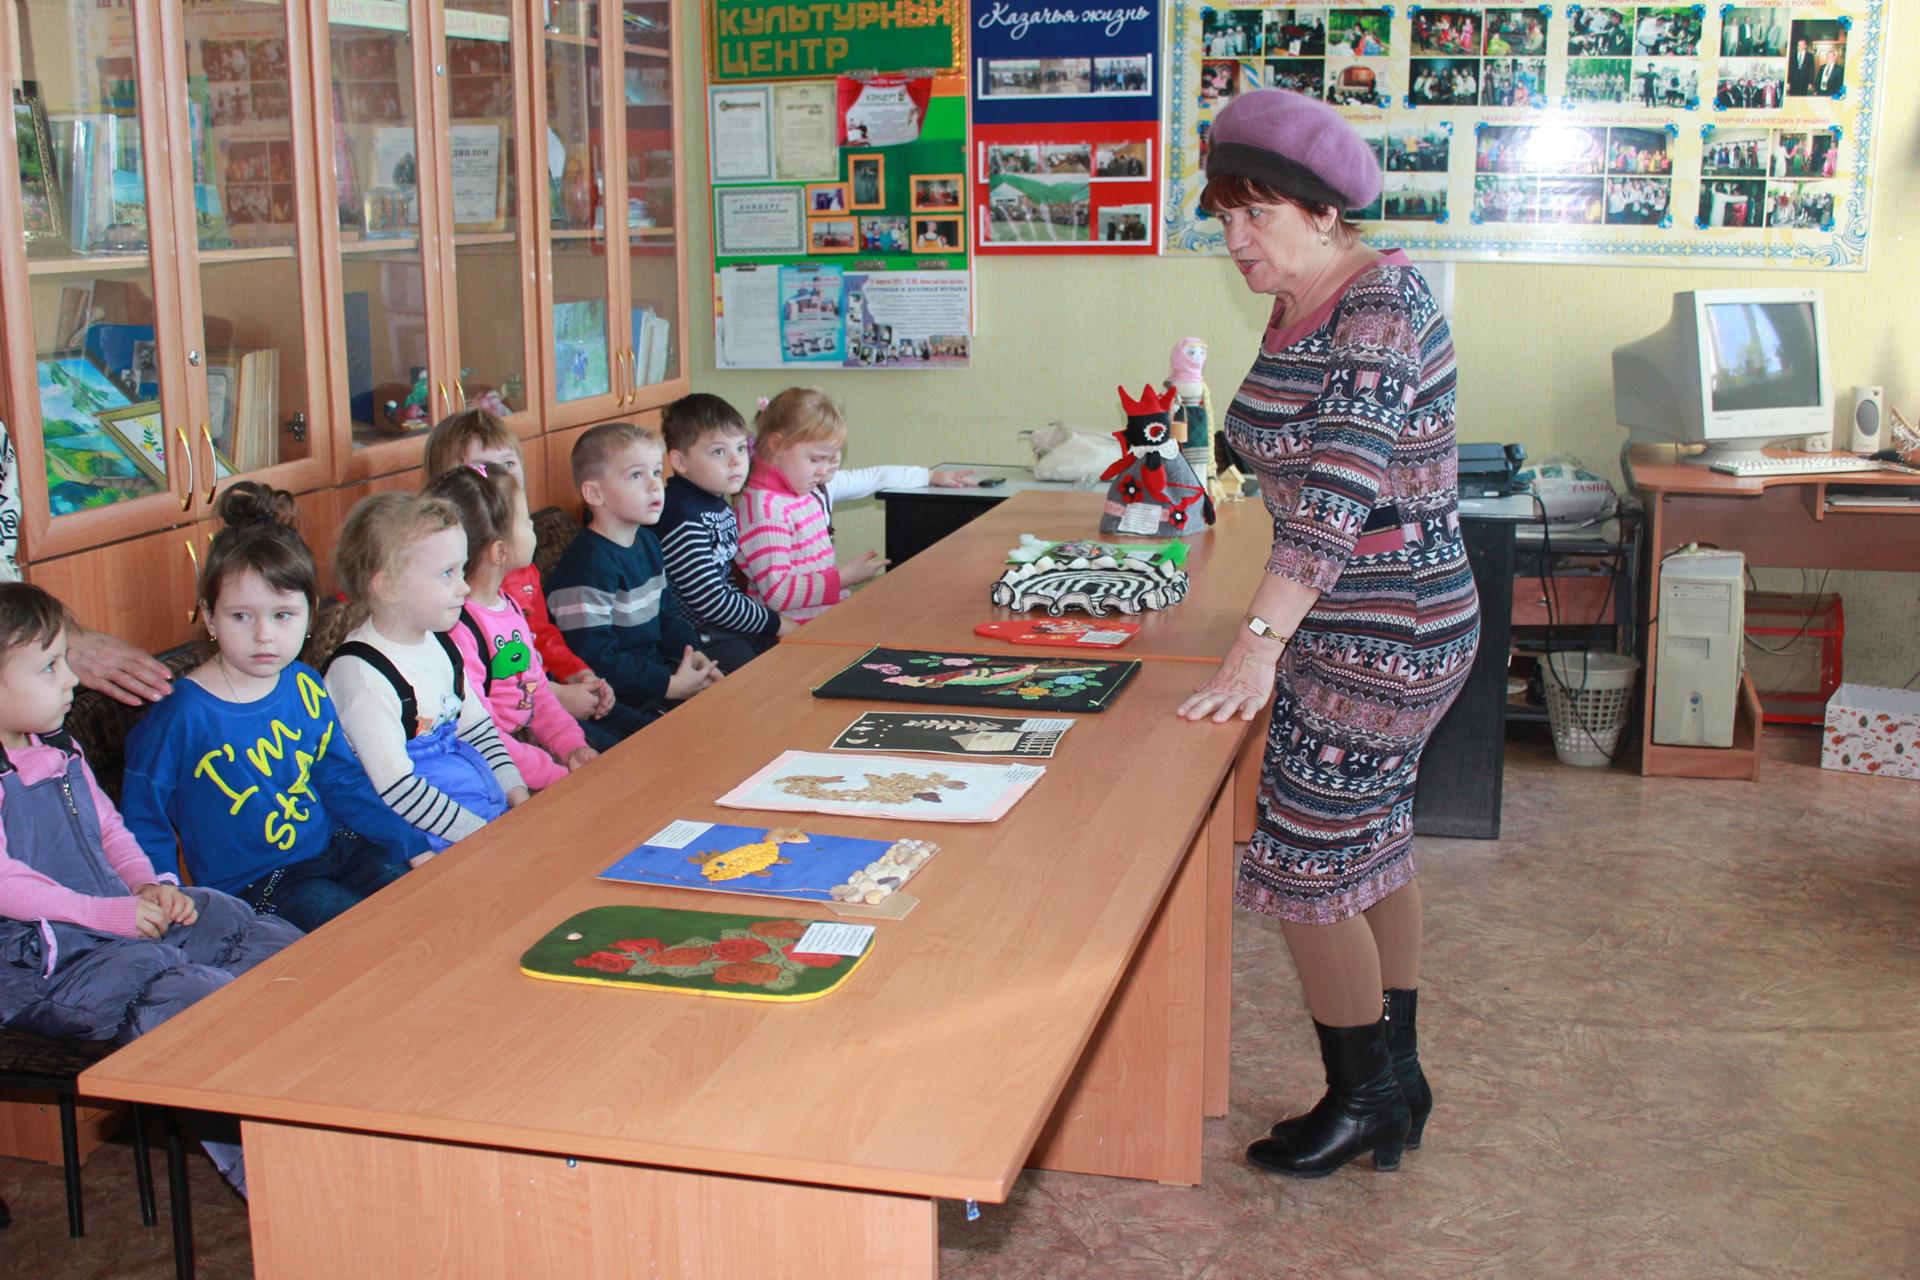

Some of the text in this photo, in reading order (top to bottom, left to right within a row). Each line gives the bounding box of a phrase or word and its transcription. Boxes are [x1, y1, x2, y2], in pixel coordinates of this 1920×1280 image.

[978, 2, 1150, 40] Казачья жизнь
[722, 37, 848, 75] ЦЕНТР
